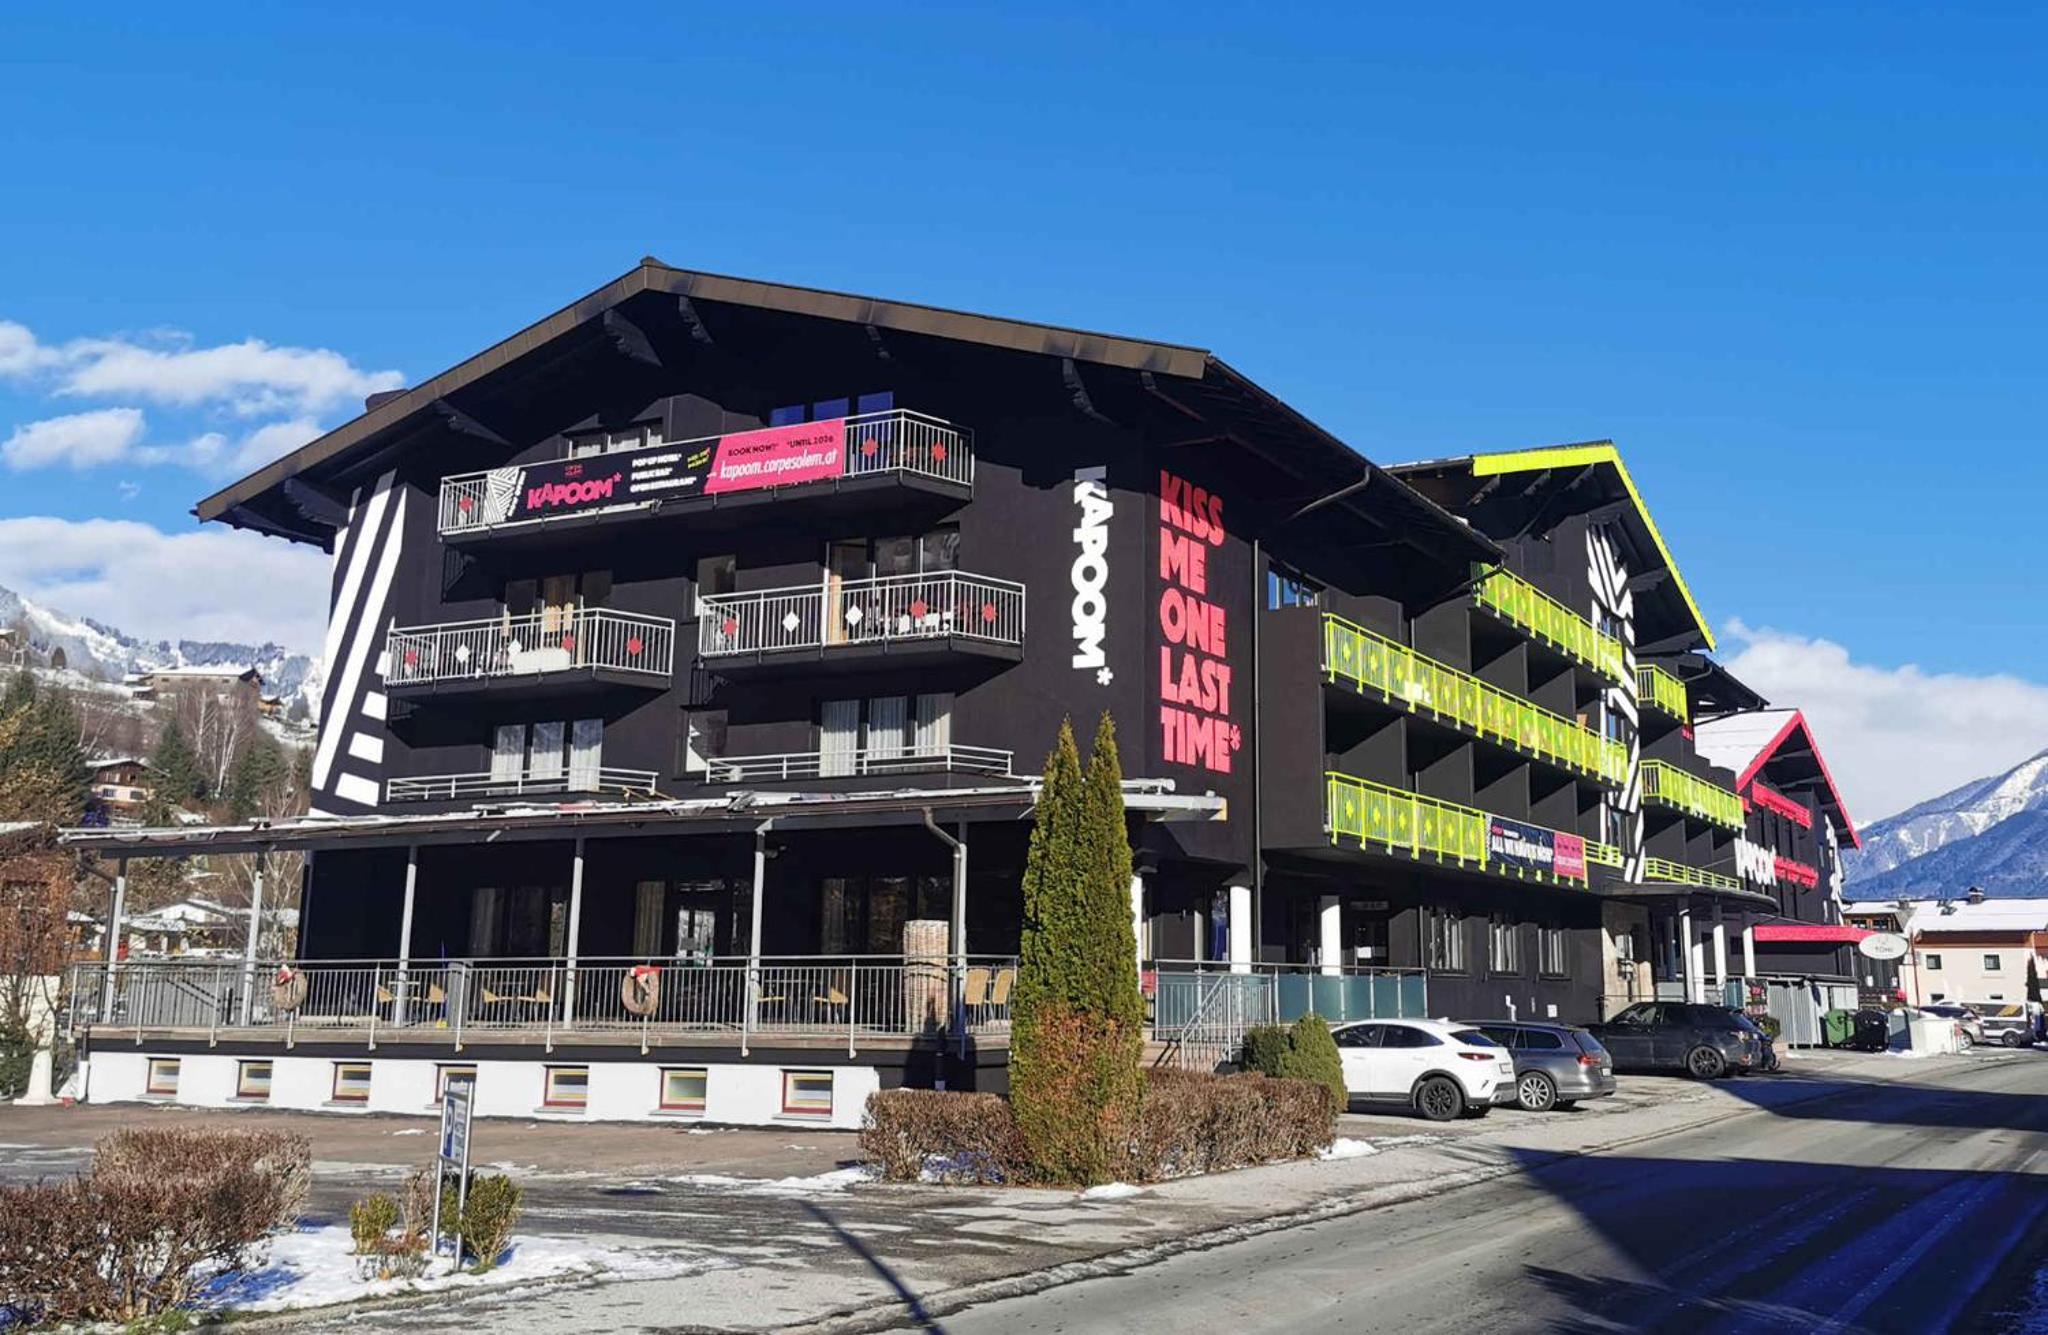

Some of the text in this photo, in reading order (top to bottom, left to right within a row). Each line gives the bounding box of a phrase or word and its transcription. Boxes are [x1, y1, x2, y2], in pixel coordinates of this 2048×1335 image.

[1159, 469, 1225, 549] KISS
[1159, 526, 1206, 596] ME
[1159, 587, 1227, 659] ONE
[1159, 645, 1231, 716] LAST
